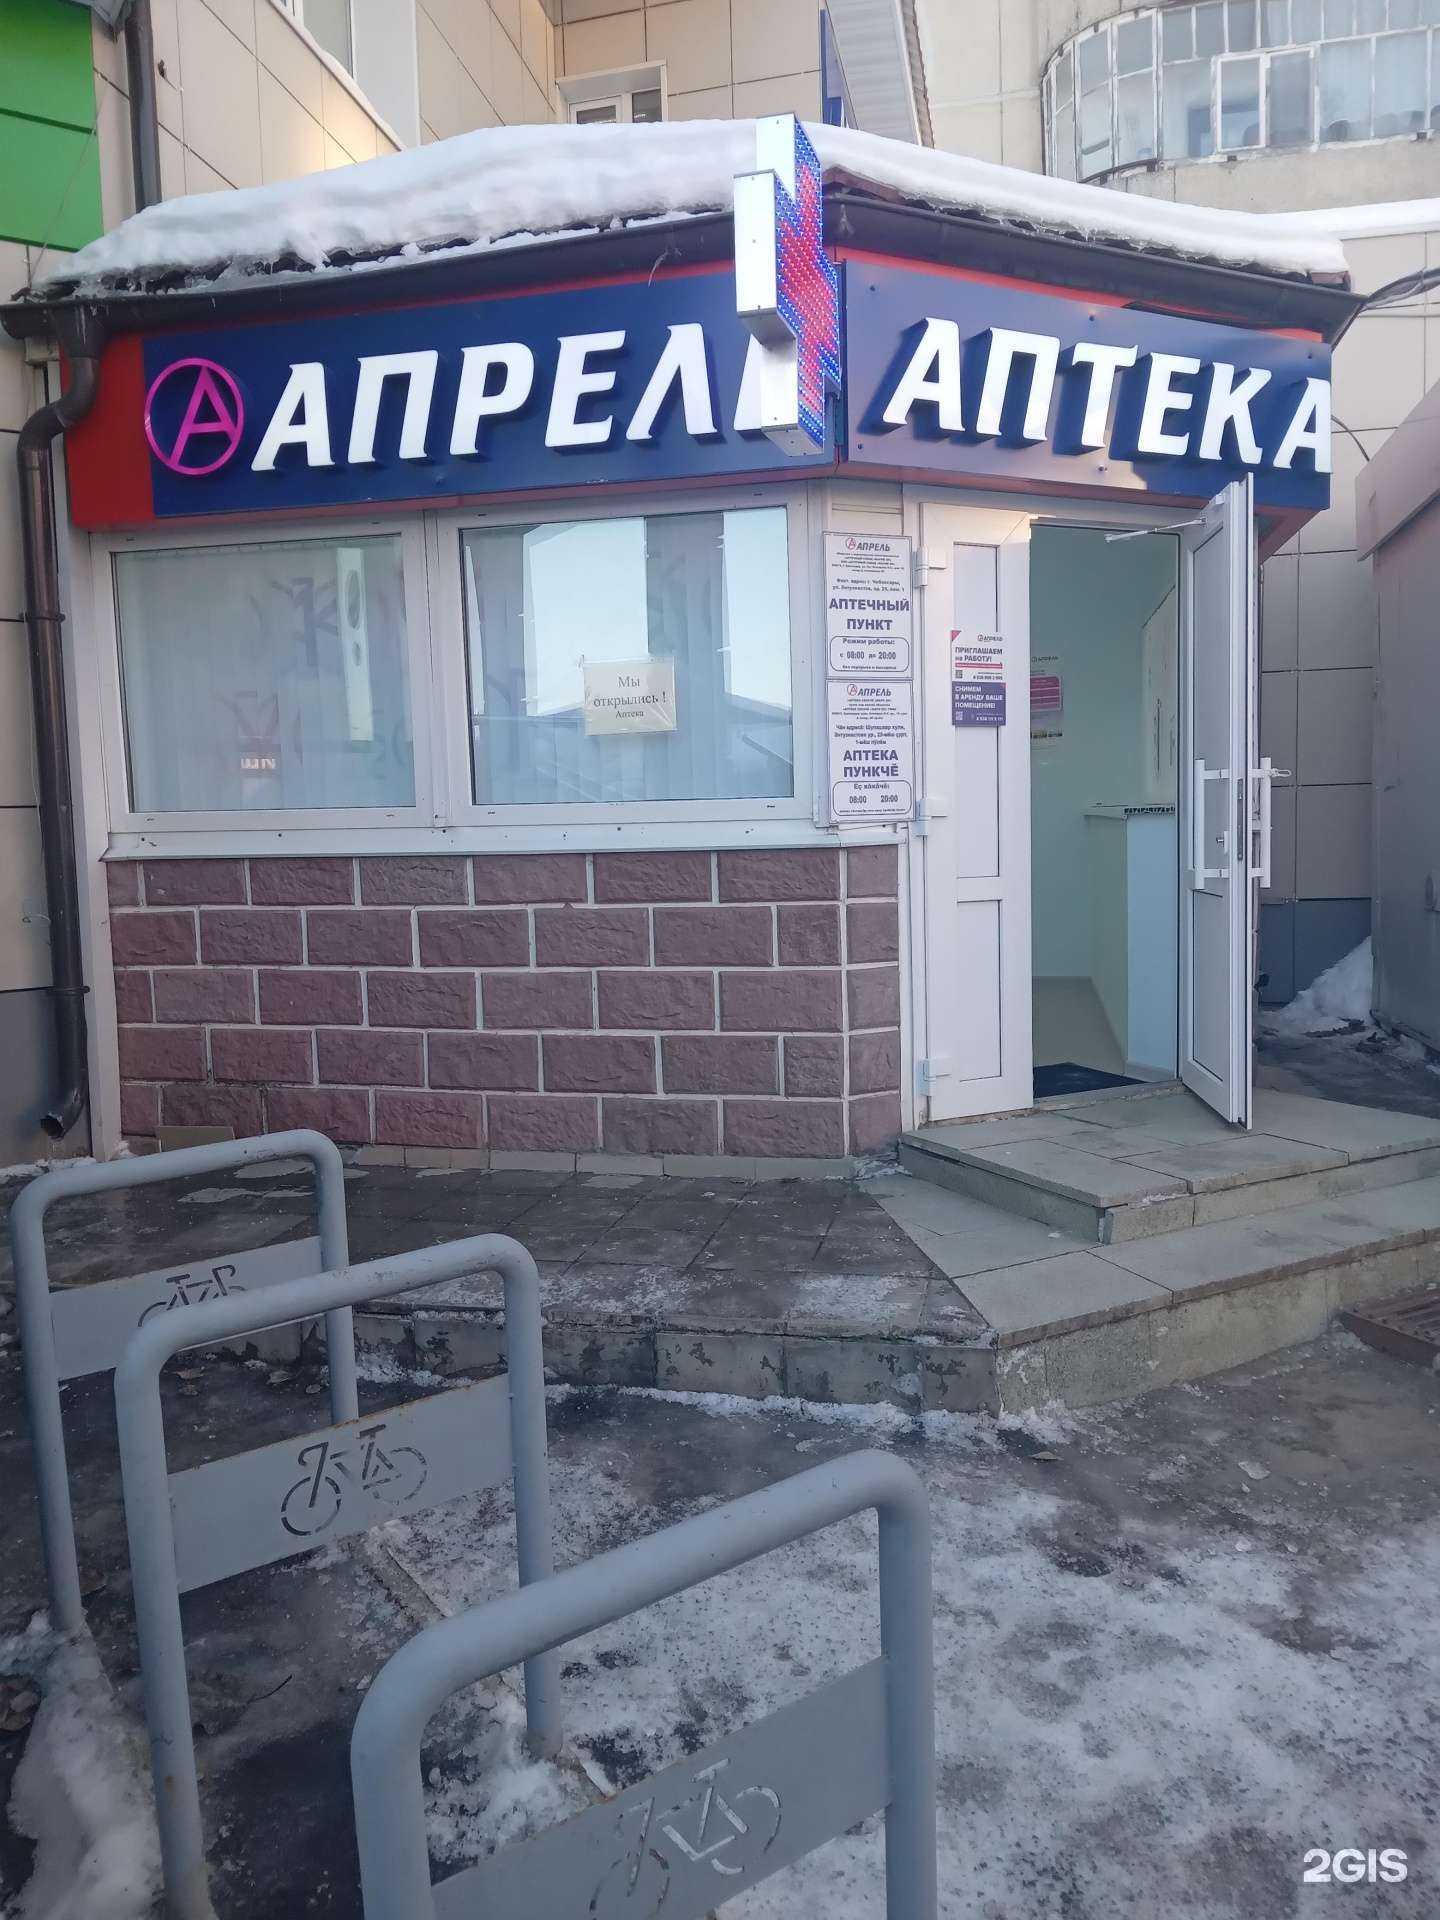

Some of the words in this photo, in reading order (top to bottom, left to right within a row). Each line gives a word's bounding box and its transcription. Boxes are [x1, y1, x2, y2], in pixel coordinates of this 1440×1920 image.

[881, 316, 1334, 474] АПТЕКА
[857, 542, 891, 552] АПРЕЛЬ
[829, 598, 910, 611] АПТЕЧНЫЙ
[847, 618, 893, 630] ПУНКТ
[847, 651, 865, 660] 08:00
[878, 652, 897, 660] 20:00
[955, 646, 1003, 655] ПРИГЛАШАЕМ
[618, 676, 641, 688] Мы
[858, 688, 892, 697] АПРЕЛЬ
[593, 695, 659, 708] открылись
[616, 710, 645, 718] Аптека
[843, 750, 899, 761] АПТЕКА
[850, 796, 867, 804] 08:00
[881, 795, 898, 803] 20:00
